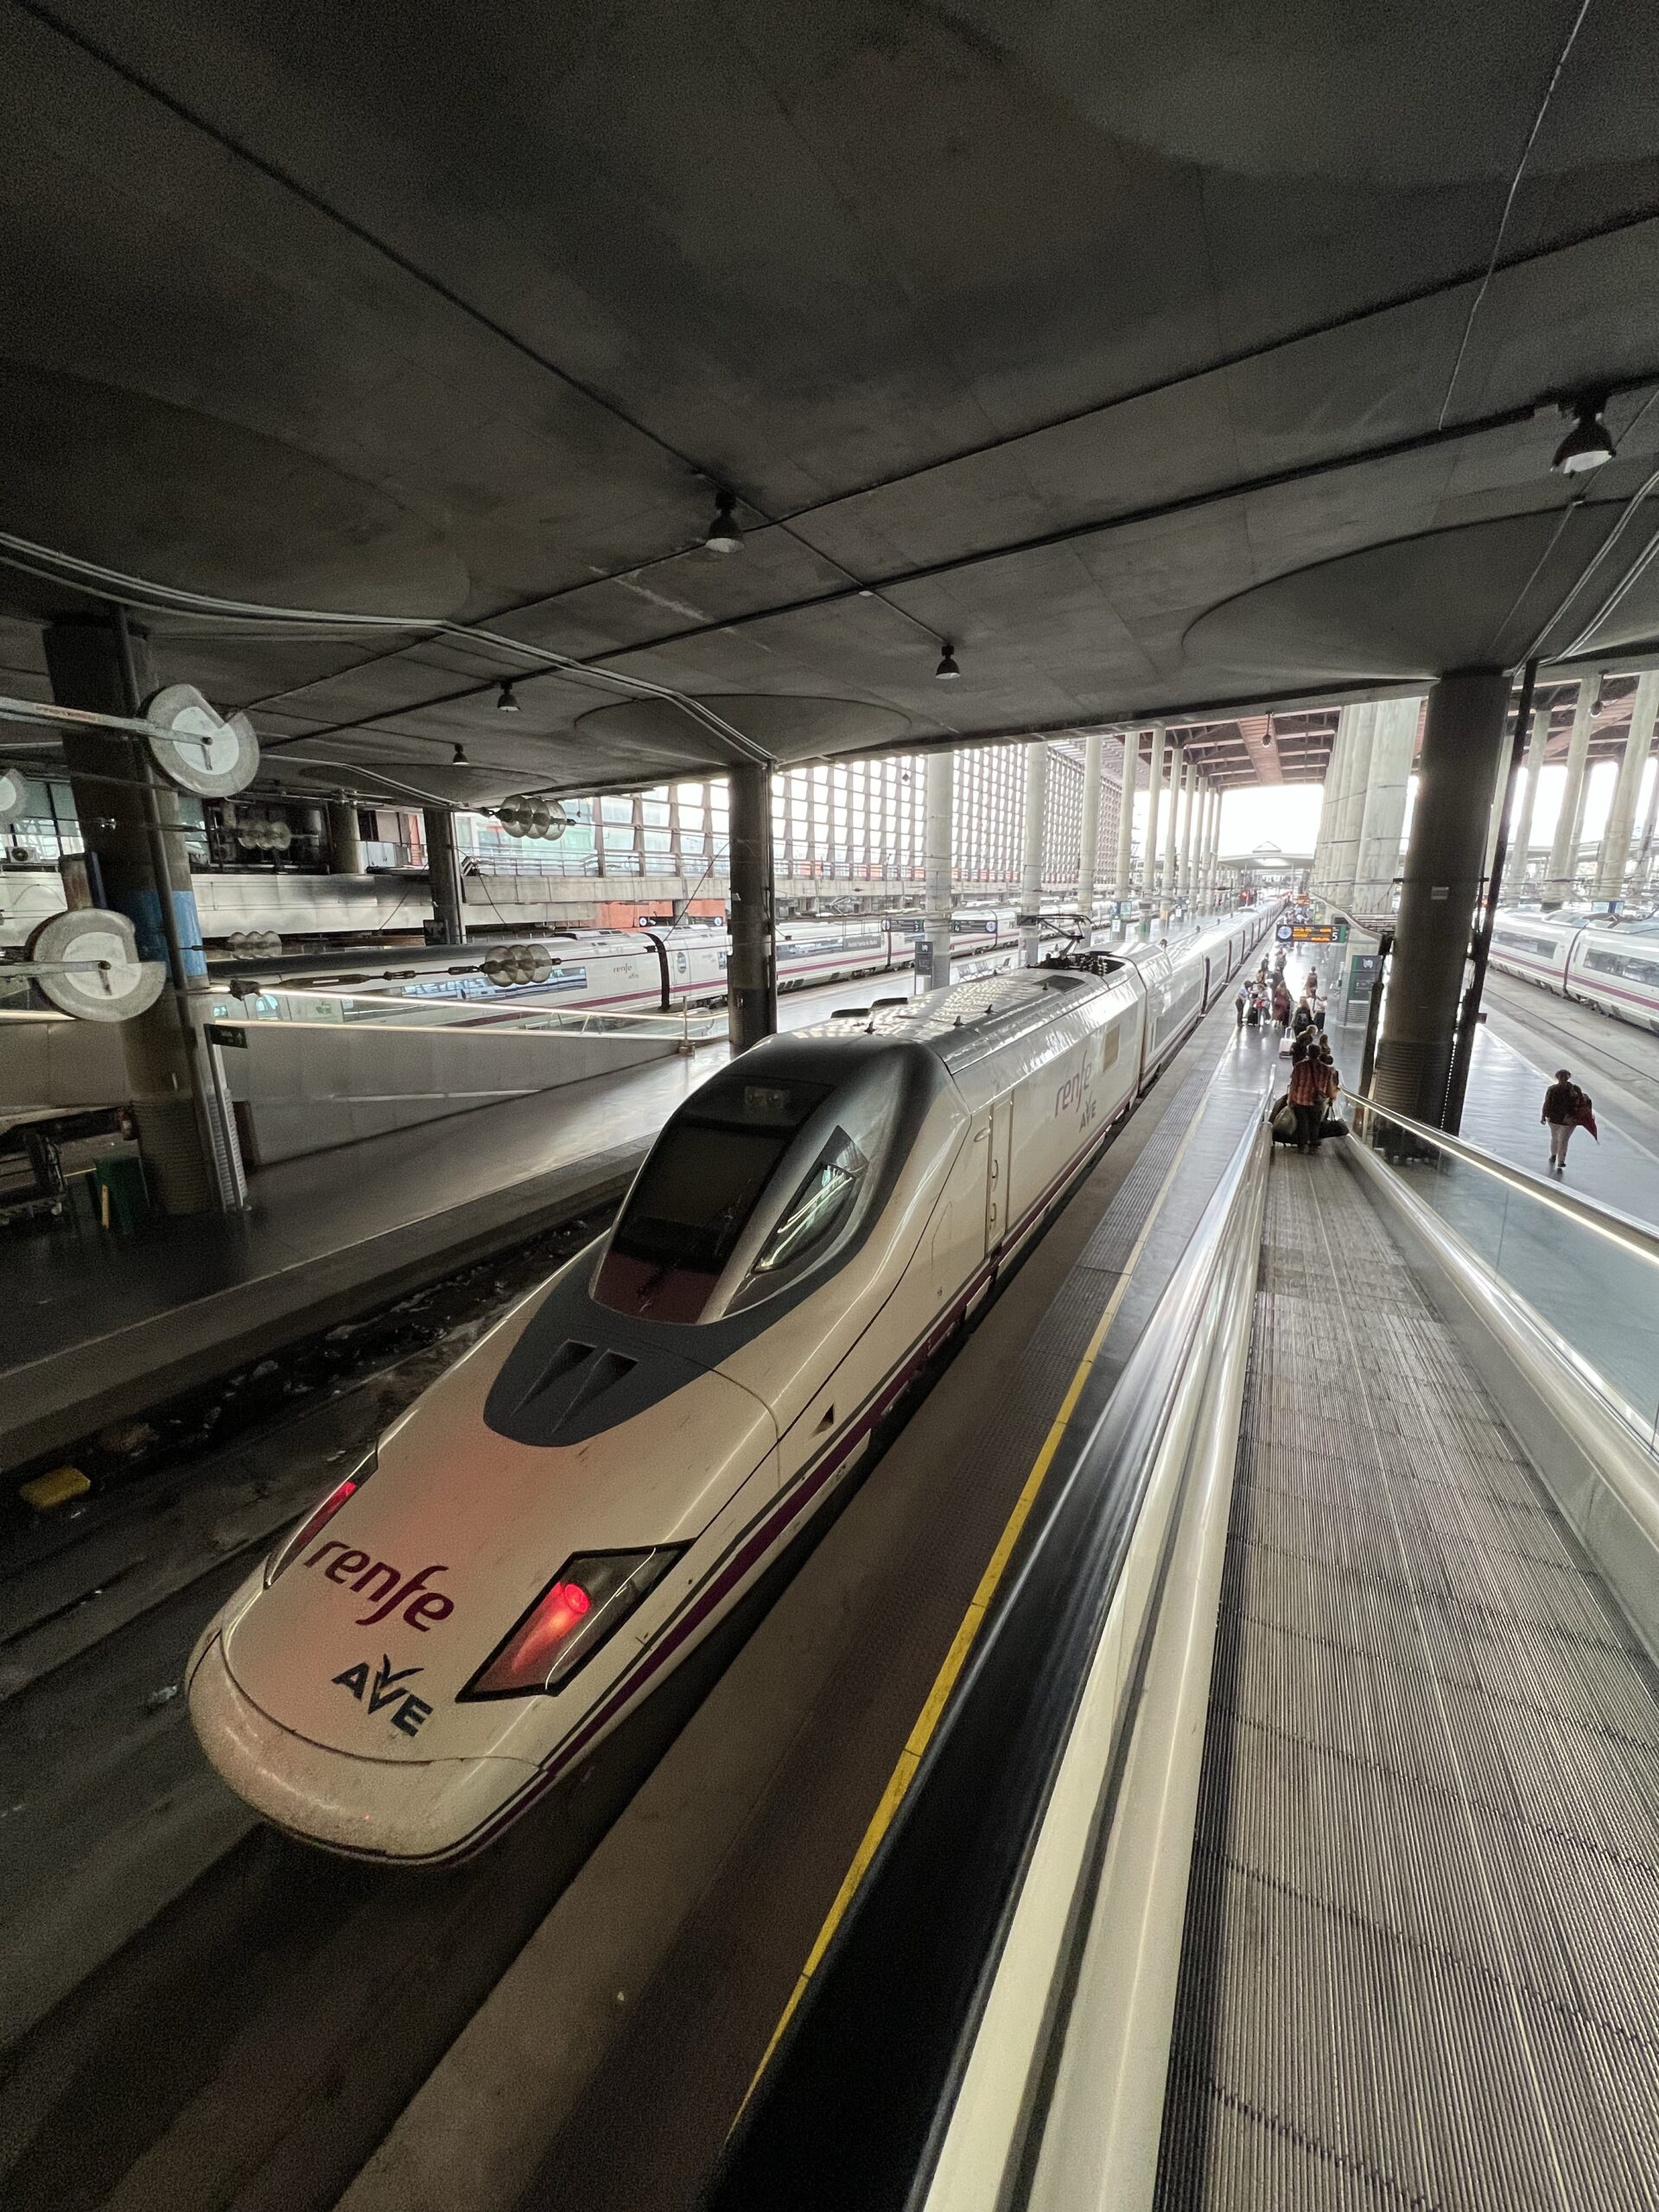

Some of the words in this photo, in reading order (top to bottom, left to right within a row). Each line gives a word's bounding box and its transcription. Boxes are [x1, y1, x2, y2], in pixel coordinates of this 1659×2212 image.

[1332, 931, 1338, 941] 5
[1054, 1050, 1092, 1118] renfe
[1078, 1090, 1097, 1134] AVE
[303, 1540, 454, 1632] renfe
[331, 1653, 433, 1738] AVE
